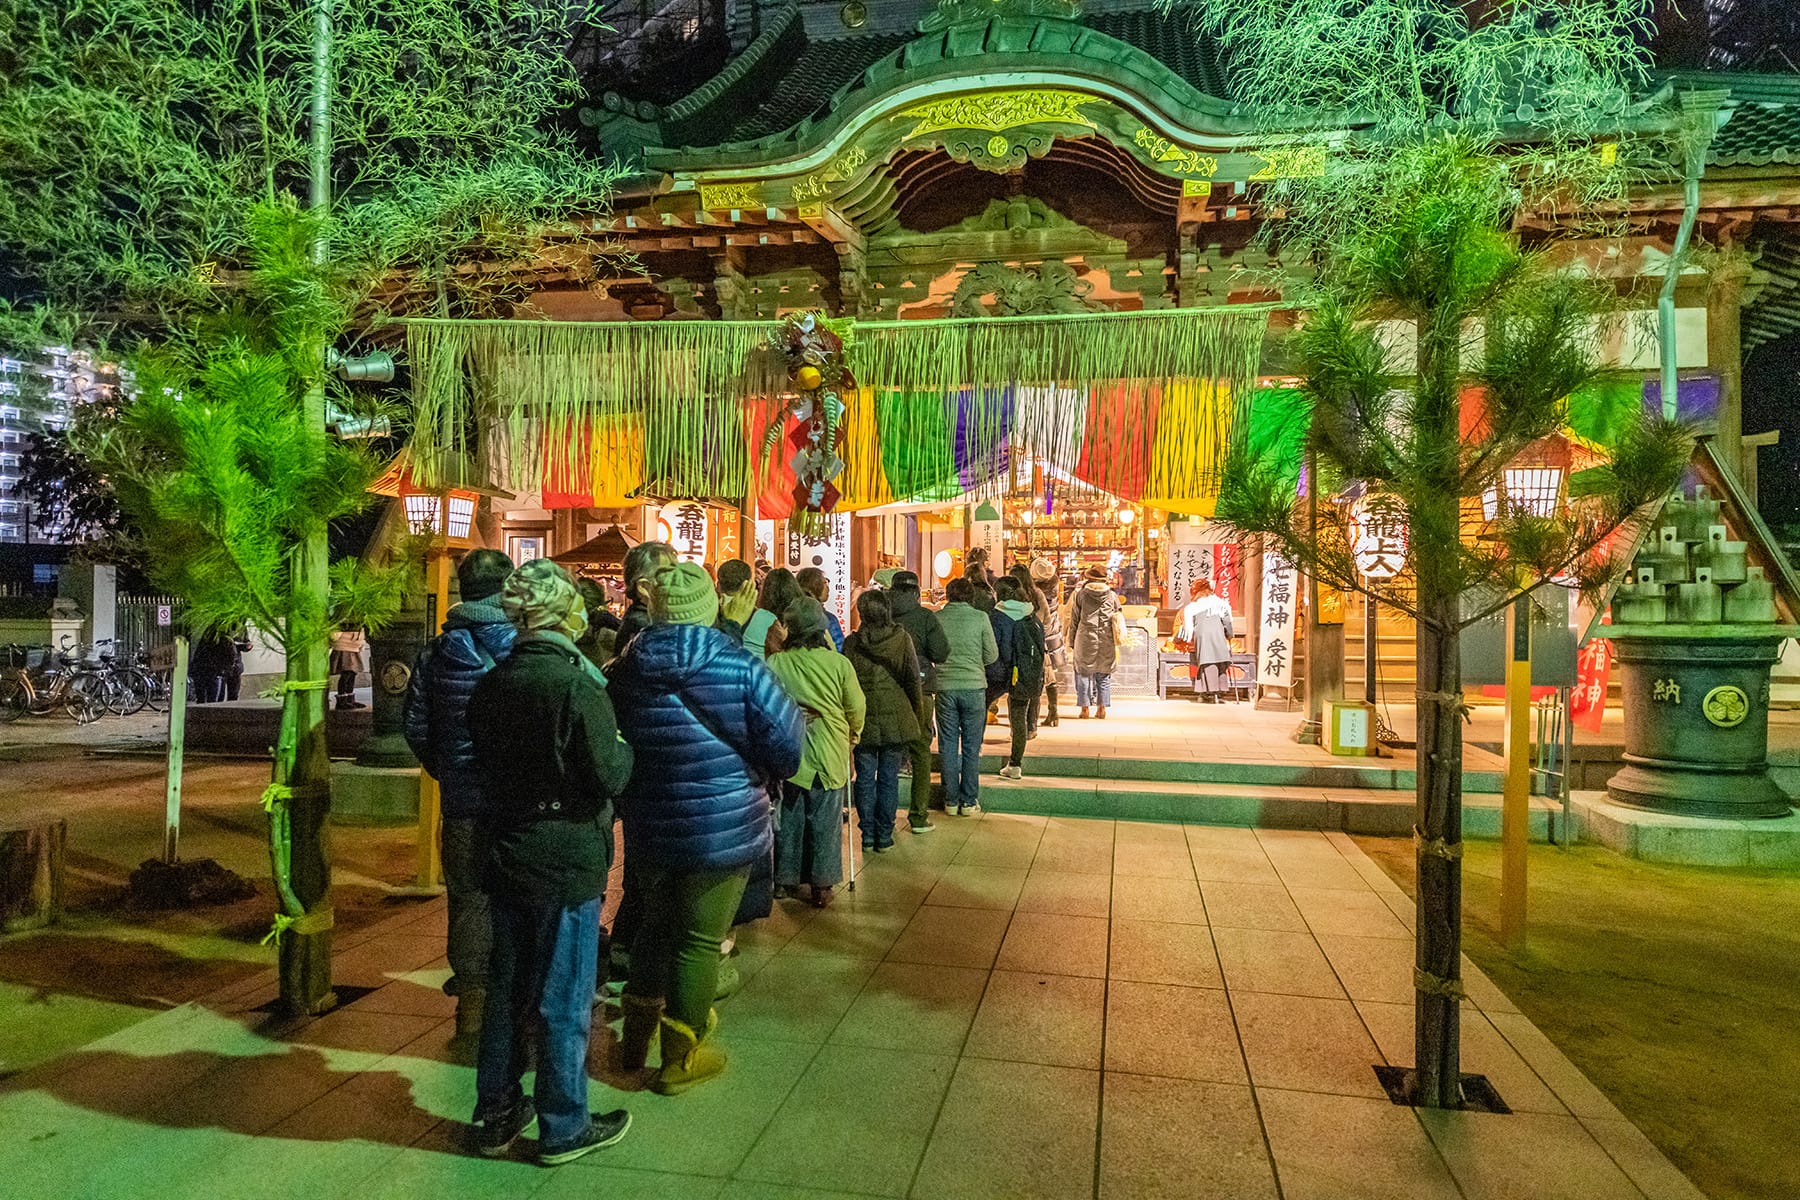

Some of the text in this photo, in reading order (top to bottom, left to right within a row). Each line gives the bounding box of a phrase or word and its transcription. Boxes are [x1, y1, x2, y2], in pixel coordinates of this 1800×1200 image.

[675, 504, 705, 560] 呑龍上
[722, 510, 736, 561] 龍上人
[1220, 545, 1231, 603] おびんづる
[1264, 638, 1288, 677] 受付
[1570, 610, 1609, 713] 福神
[1653, 679, 1681, 705] 納
